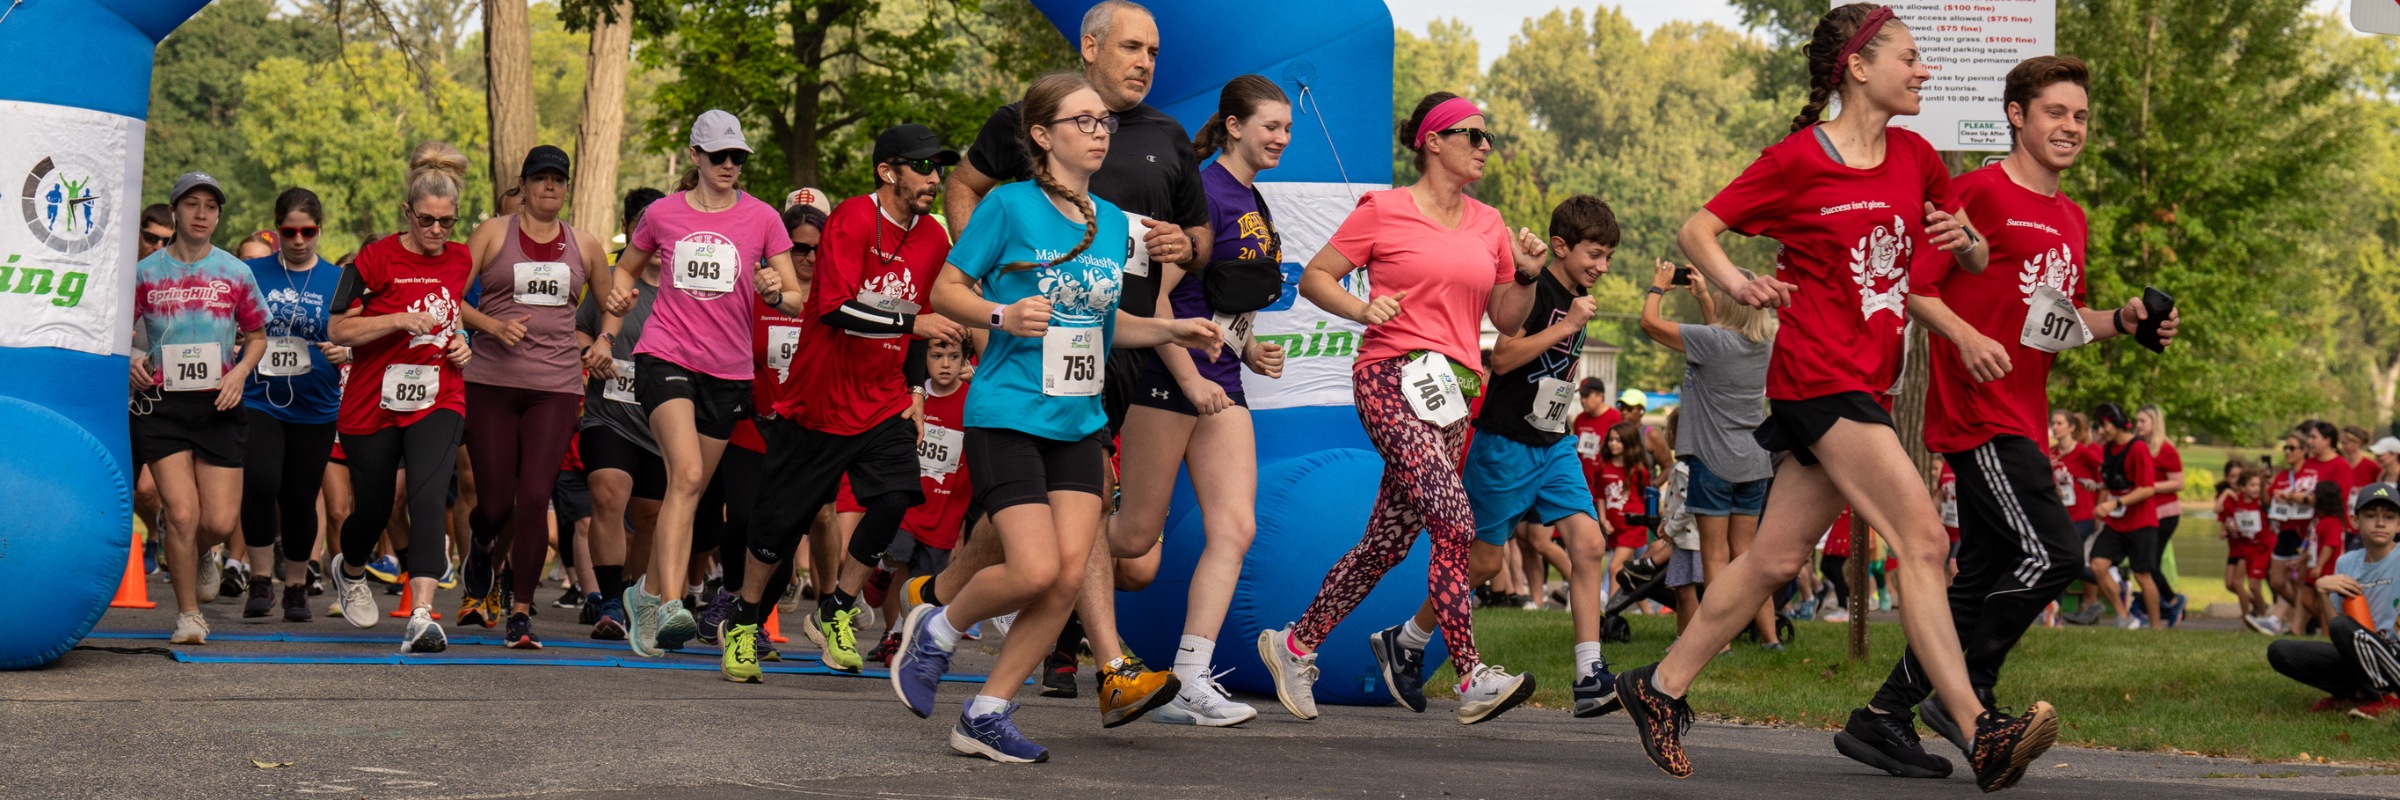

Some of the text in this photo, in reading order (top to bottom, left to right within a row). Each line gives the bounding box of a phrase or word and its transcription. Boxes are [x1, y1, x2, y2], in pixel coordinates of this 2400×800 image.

[1917, 46, 1951, 54] ignated
[1926, 56, 1958, 64] Grilling
[1820, 203, 1851, 216] Success
[1851, 201, 1868, 210] isn't
[687, 260, 720, 280] 943
[0, 254, 89, 308] ing
[527, 279, 558, 296] 846
[301, 297, 323, 306] Places!
[303, 291, 323, 301] Going
[2041, 312, 2075, 341] 917
[271, 351, 298, 367] 873
[1063, 355, 1095, 381] 753
[177, 362, 208, 380] 749
[396, 383, 427, 401] 829
[1412, 373, 1447, 411] 746
[1545, 401, 1566, 421] 747
[917, 440, 949, 462] 935
